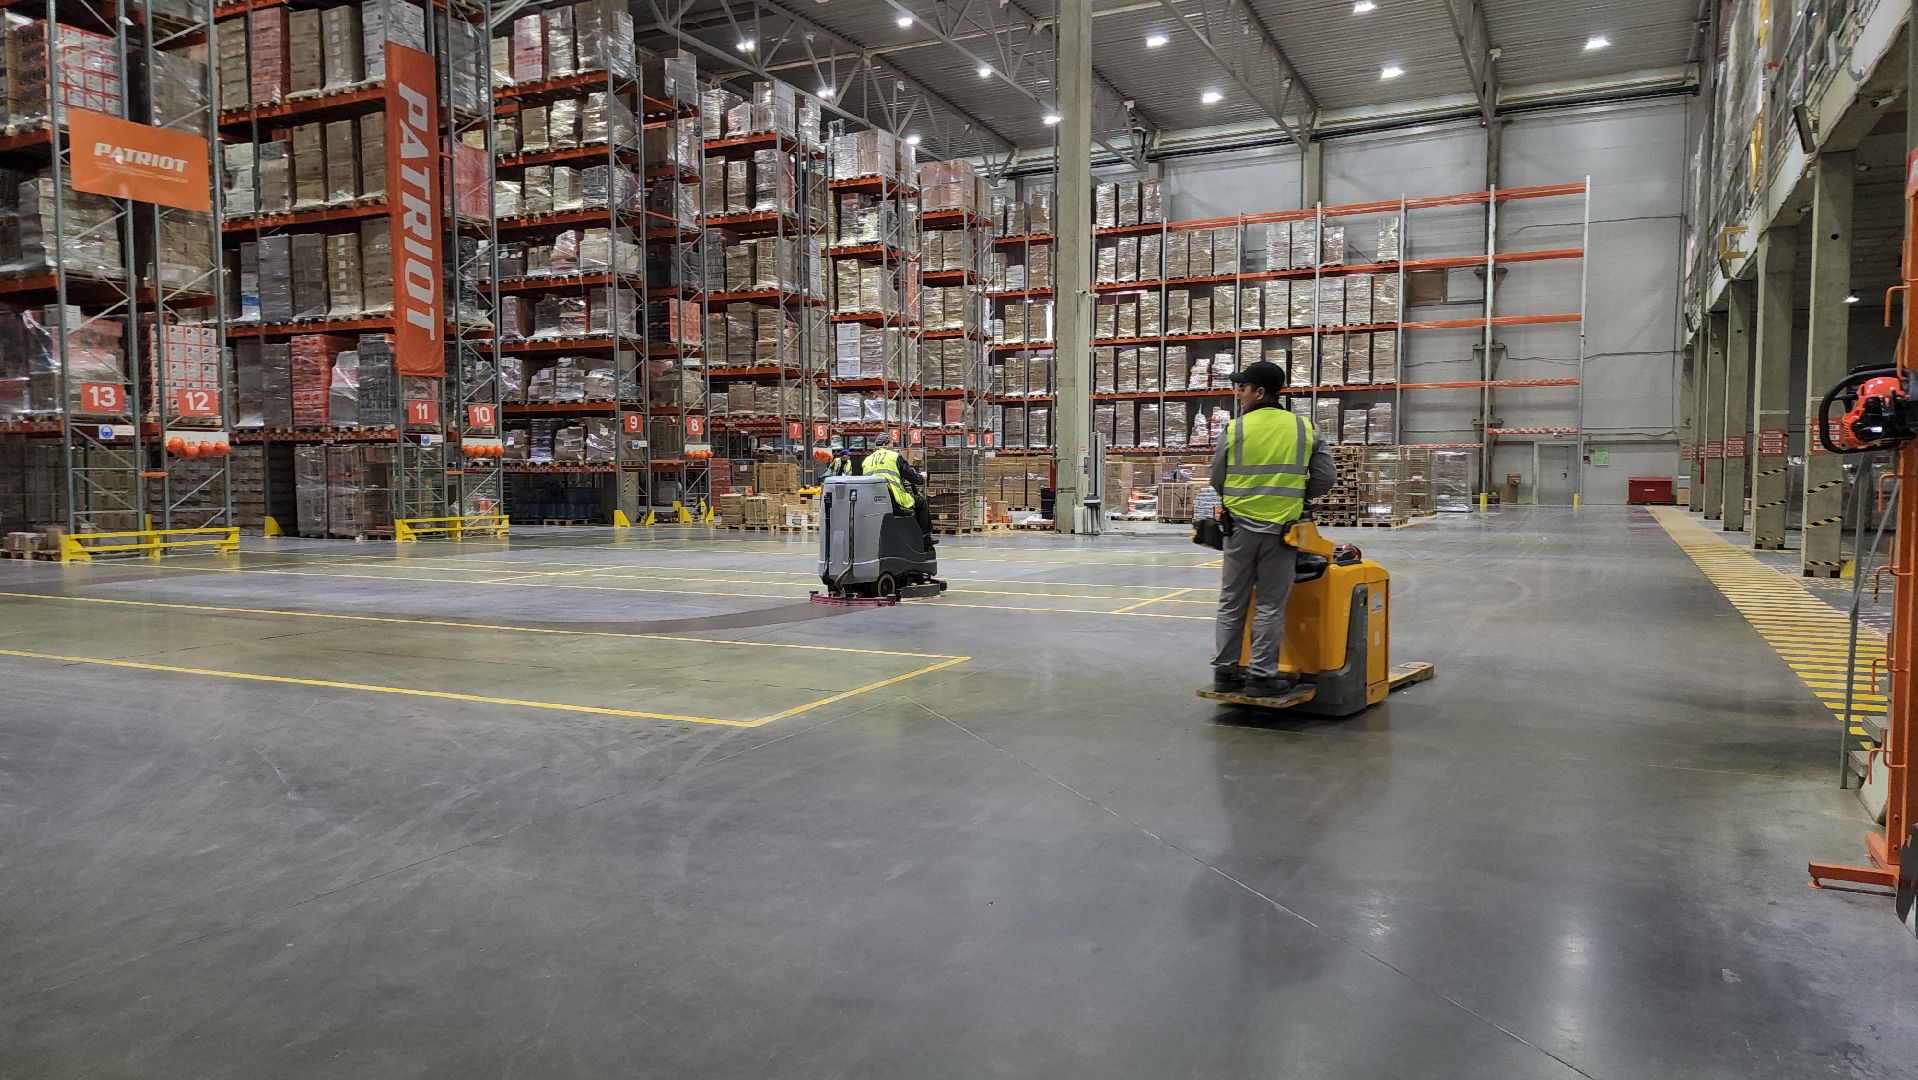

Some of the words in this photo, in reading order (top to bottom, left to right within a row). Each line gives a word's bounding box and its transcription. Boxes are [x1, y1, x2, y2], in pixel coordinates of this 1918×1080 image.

[94, 142, 188, 173] PATRIOT
[398, 81, 436, 340] PATRIOT
[89, 385, 117, 408] 13
[185, 391, 211, 411] 12
[415, 402, 429, 420] 11
[473, 406, 491, 423] 10
[630, 415, 638, 430] 9
[691, 418, 699, 432] 8
[793, 423, 798, 435] 7
[817, 425, 824, 437] 6
[892, 430, 897, 440] 5
[913, 430, 918, 440] 4
[969, 434, 974, 443] 3
[987, 434, 991, 443] 2
